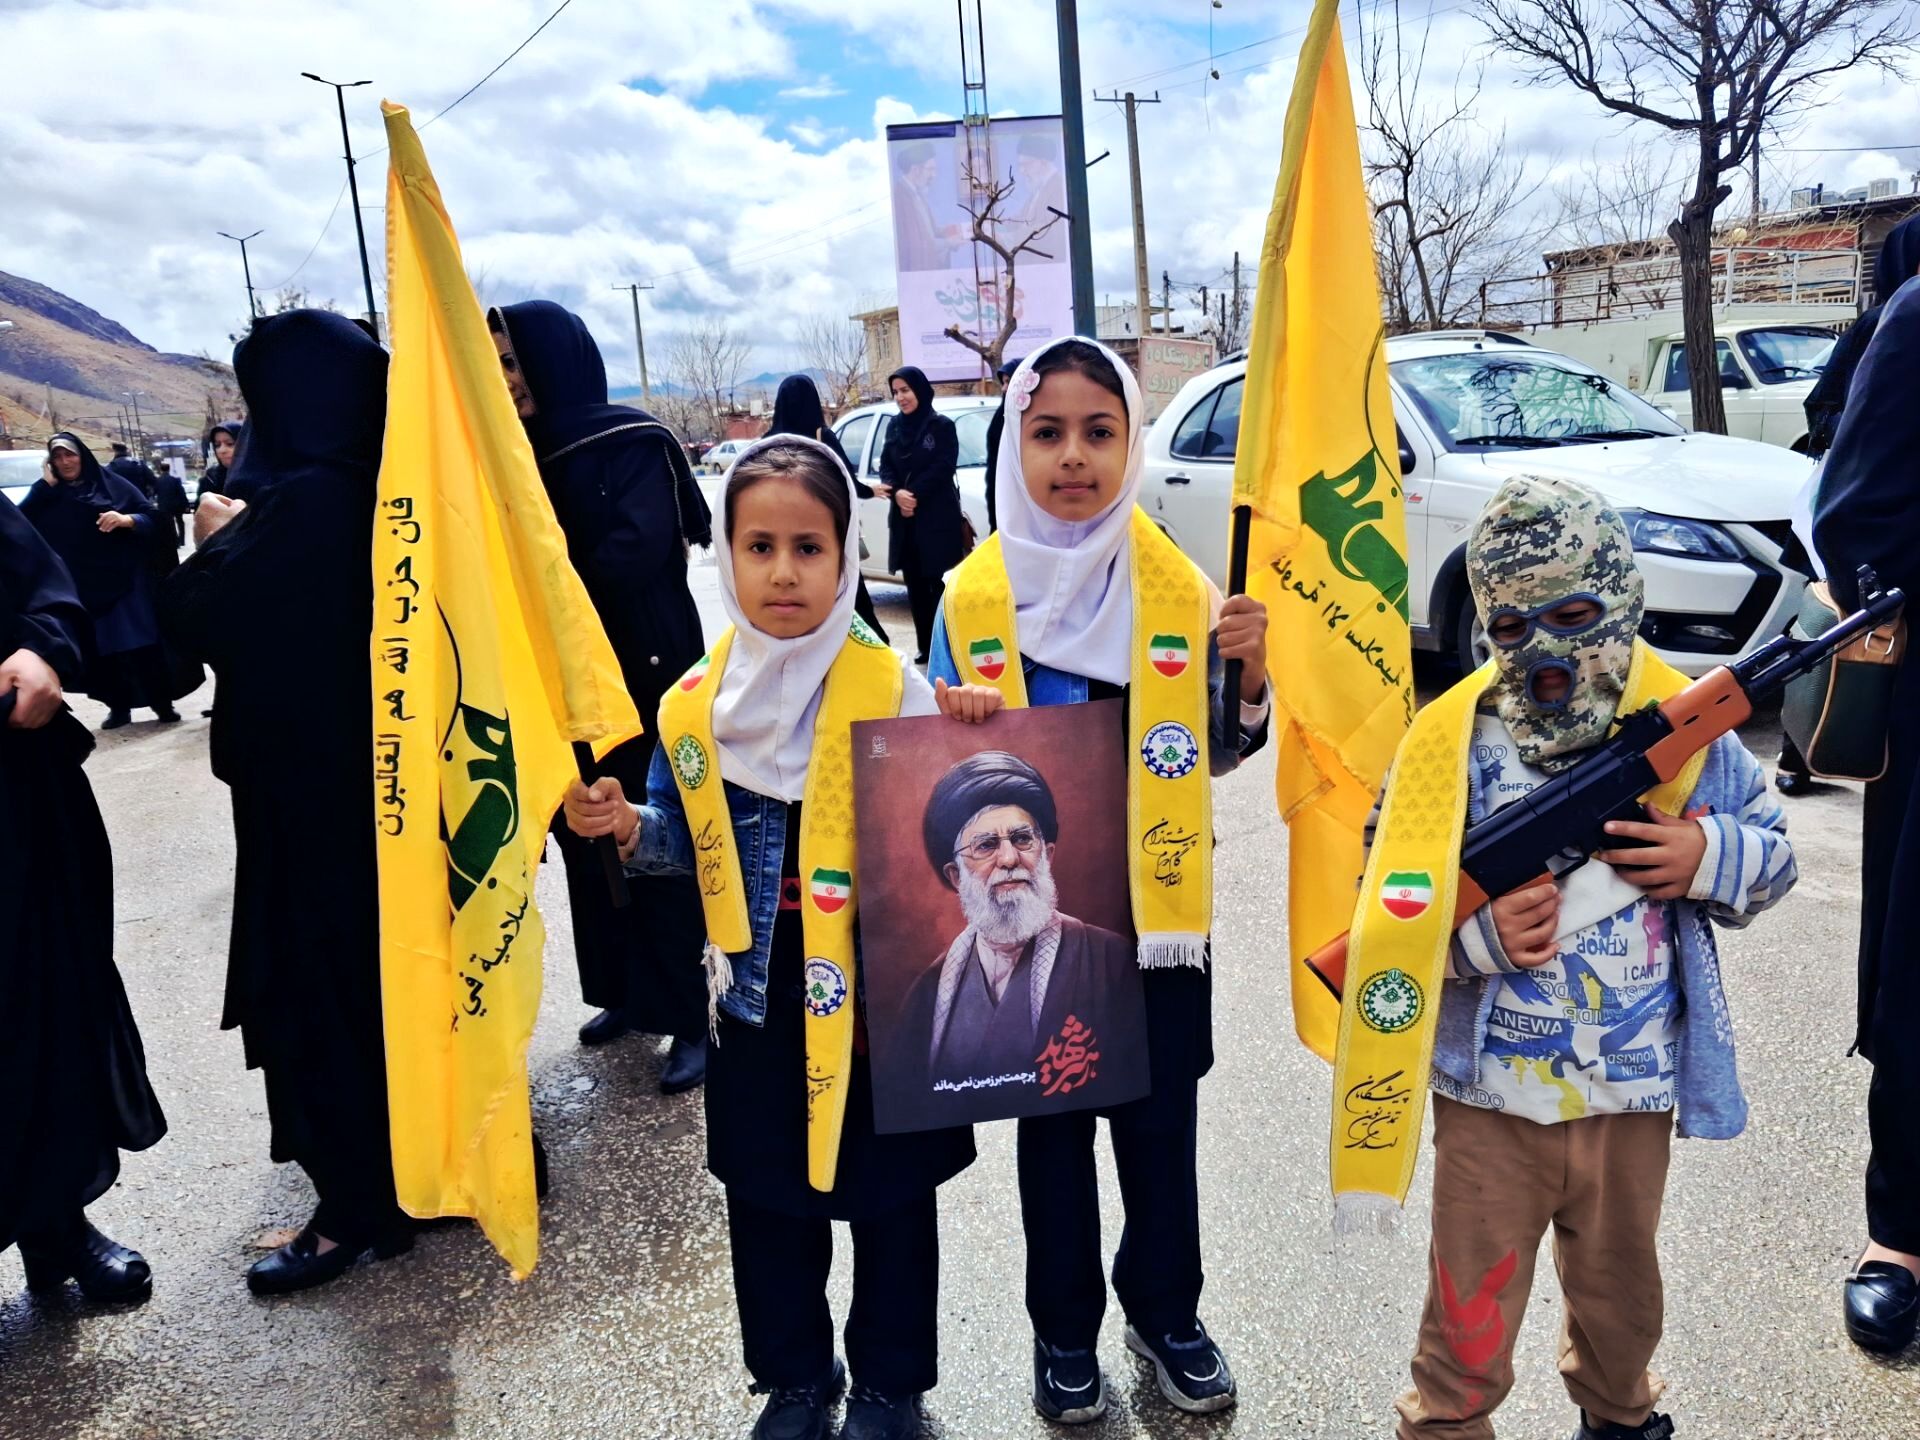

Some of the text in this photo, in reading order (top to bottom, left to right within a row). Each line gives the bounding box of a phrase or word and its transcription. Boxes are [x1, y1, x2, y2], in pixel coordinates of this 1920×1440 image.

[1146, 372, 1184, 394] اورزی
[386, 556, 419, 624] حزب
[377, 637, 410, 674] الله
[382, 690, 416, 722] هم
[375, 734, 407, 836] الغالبون
[1498, 782, 1534, 792] GHFG
[1631, 962, 1663, 981] CAN'T
[458, 971, 487, 1017] في
[1492, 1008, 1564, 1036] ANEWA
[1607, 1050, 1656, 1065] YOUKISD
[1002, 1071, 1036, 1084] پرچمت
[1621, 1064, 1647, 1077] GUN
[1622, 1090, 1670, 1111] CAN'T
